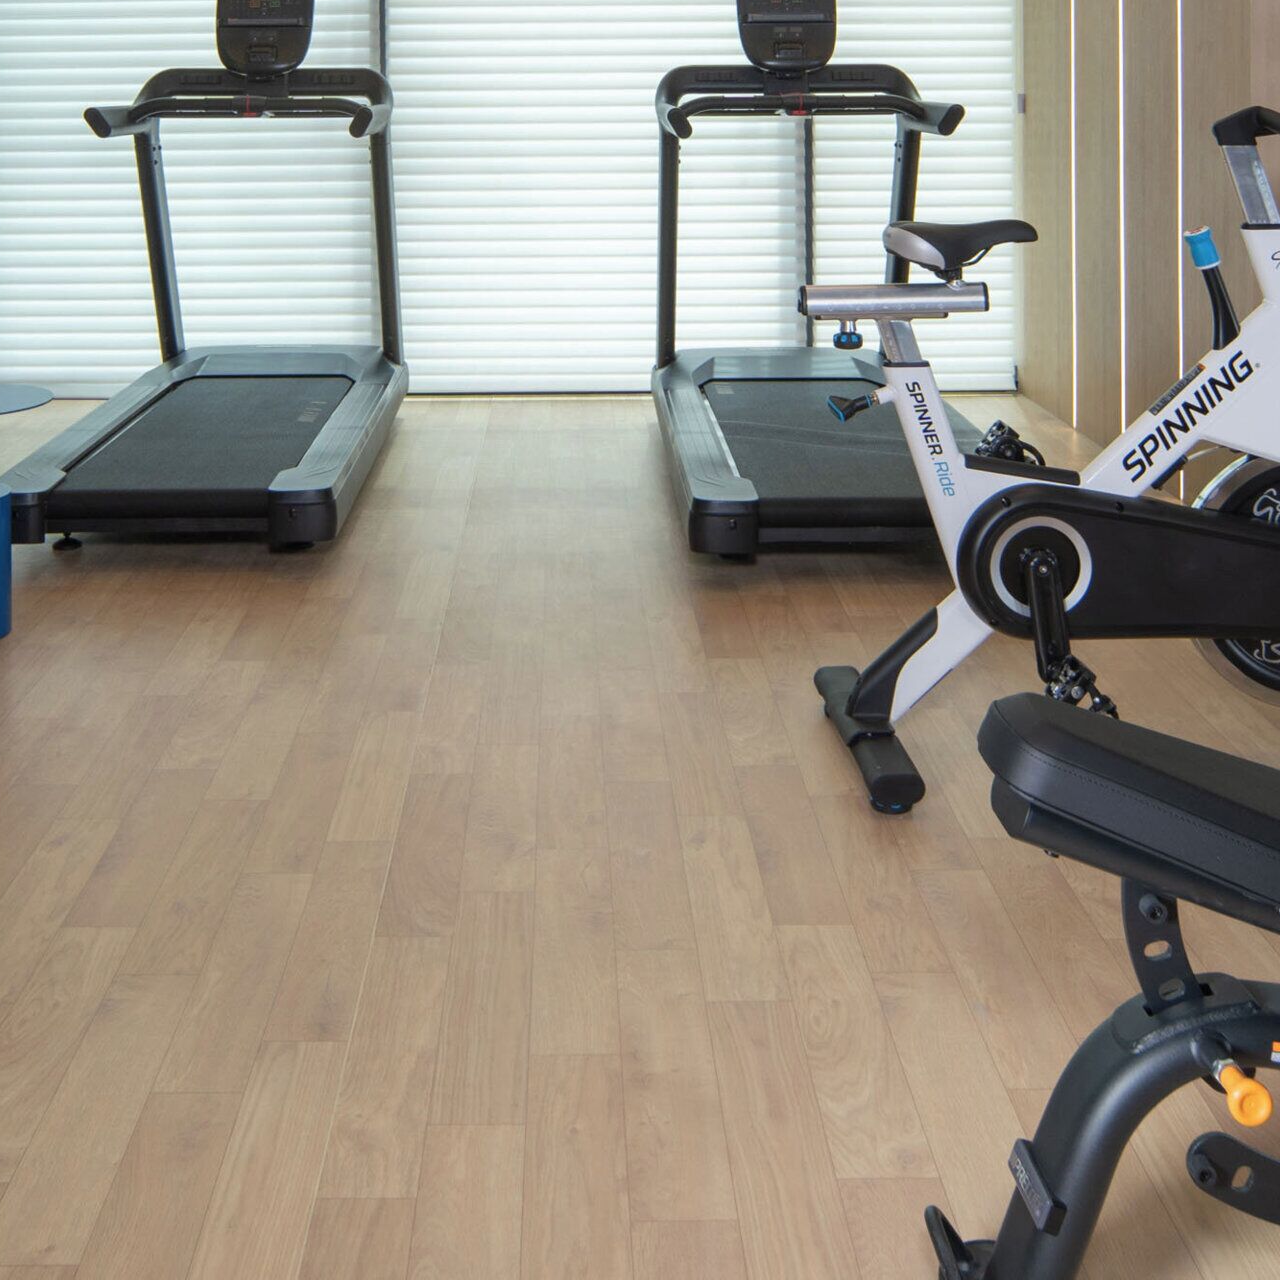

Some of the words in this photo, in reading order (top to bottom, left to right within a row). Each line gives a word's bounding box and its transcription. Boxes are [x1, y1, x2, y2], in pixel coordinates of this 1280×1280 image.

[905, 381, 943, 456] SPINNER
[934, 461, 955, 497] Ride
[1122, 350, 1254, 483] SPINNING
